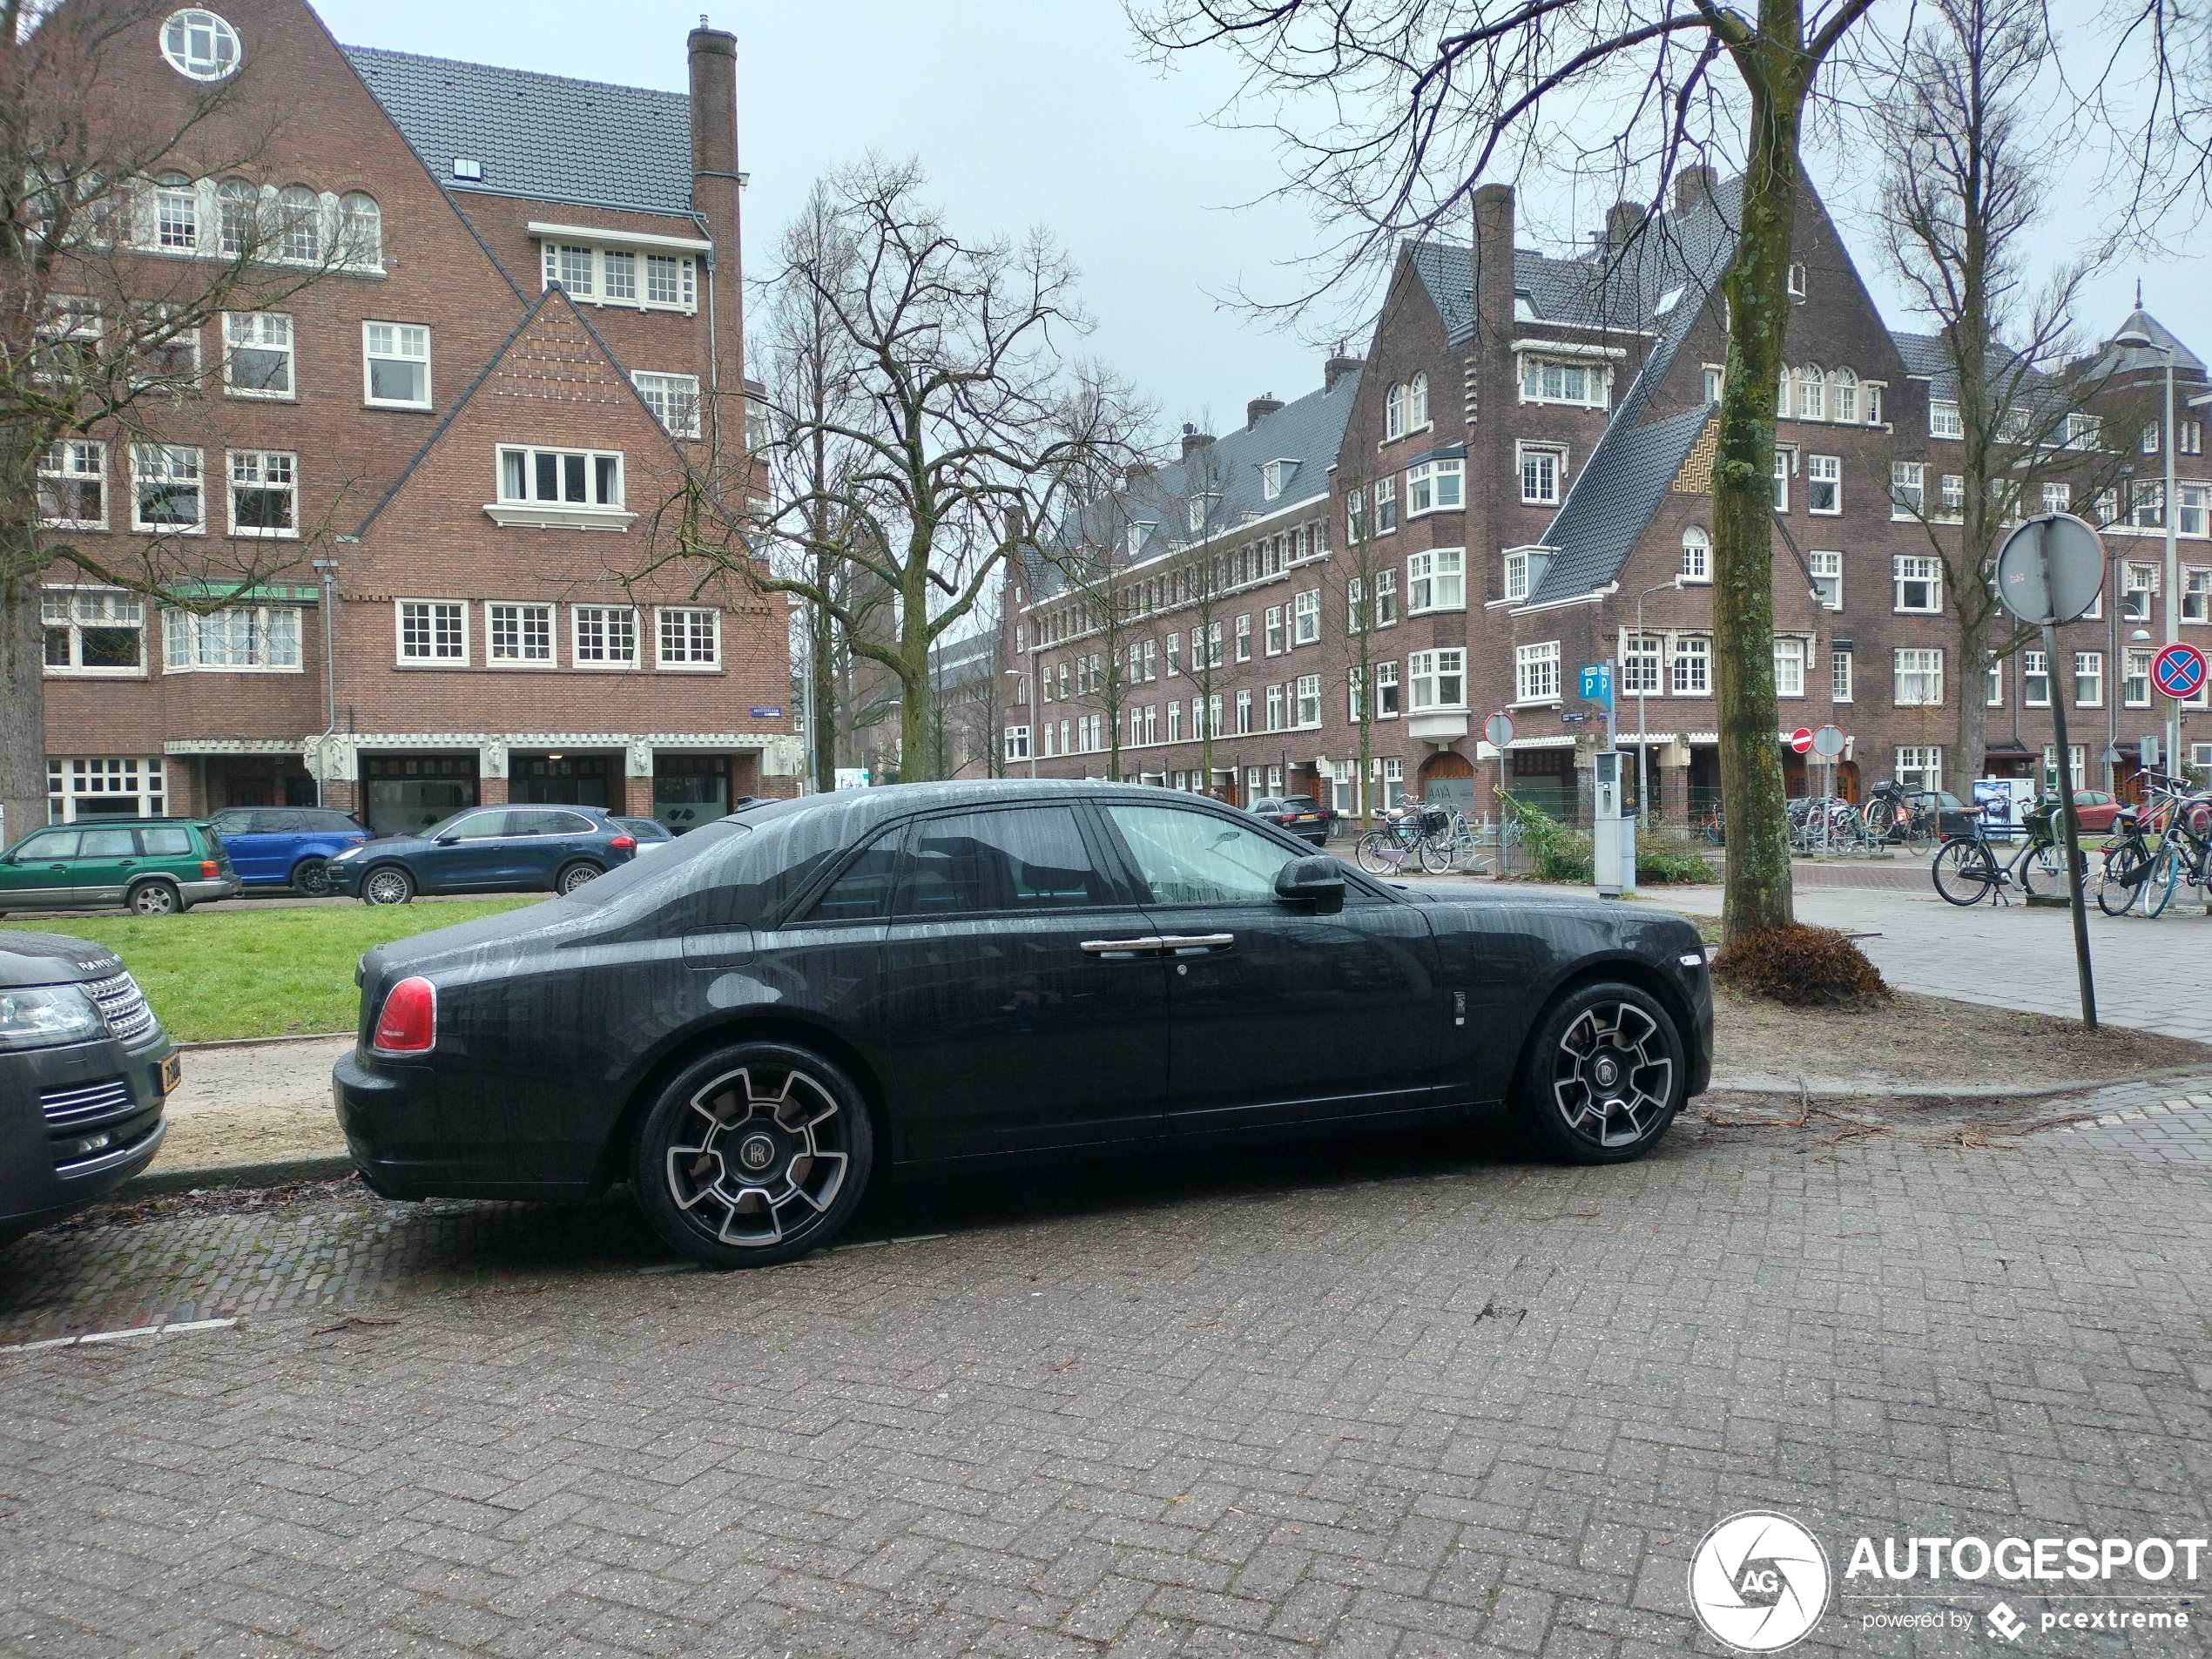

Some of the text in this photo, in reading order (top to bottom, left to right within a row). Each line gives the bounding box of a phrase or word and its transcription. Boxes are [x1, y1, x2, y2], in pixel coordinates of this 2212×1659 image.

[1585, 678, 1594, 696] P
[1602, 677, 1608, 695] P
[77, 957, 115, 972] RANGE
